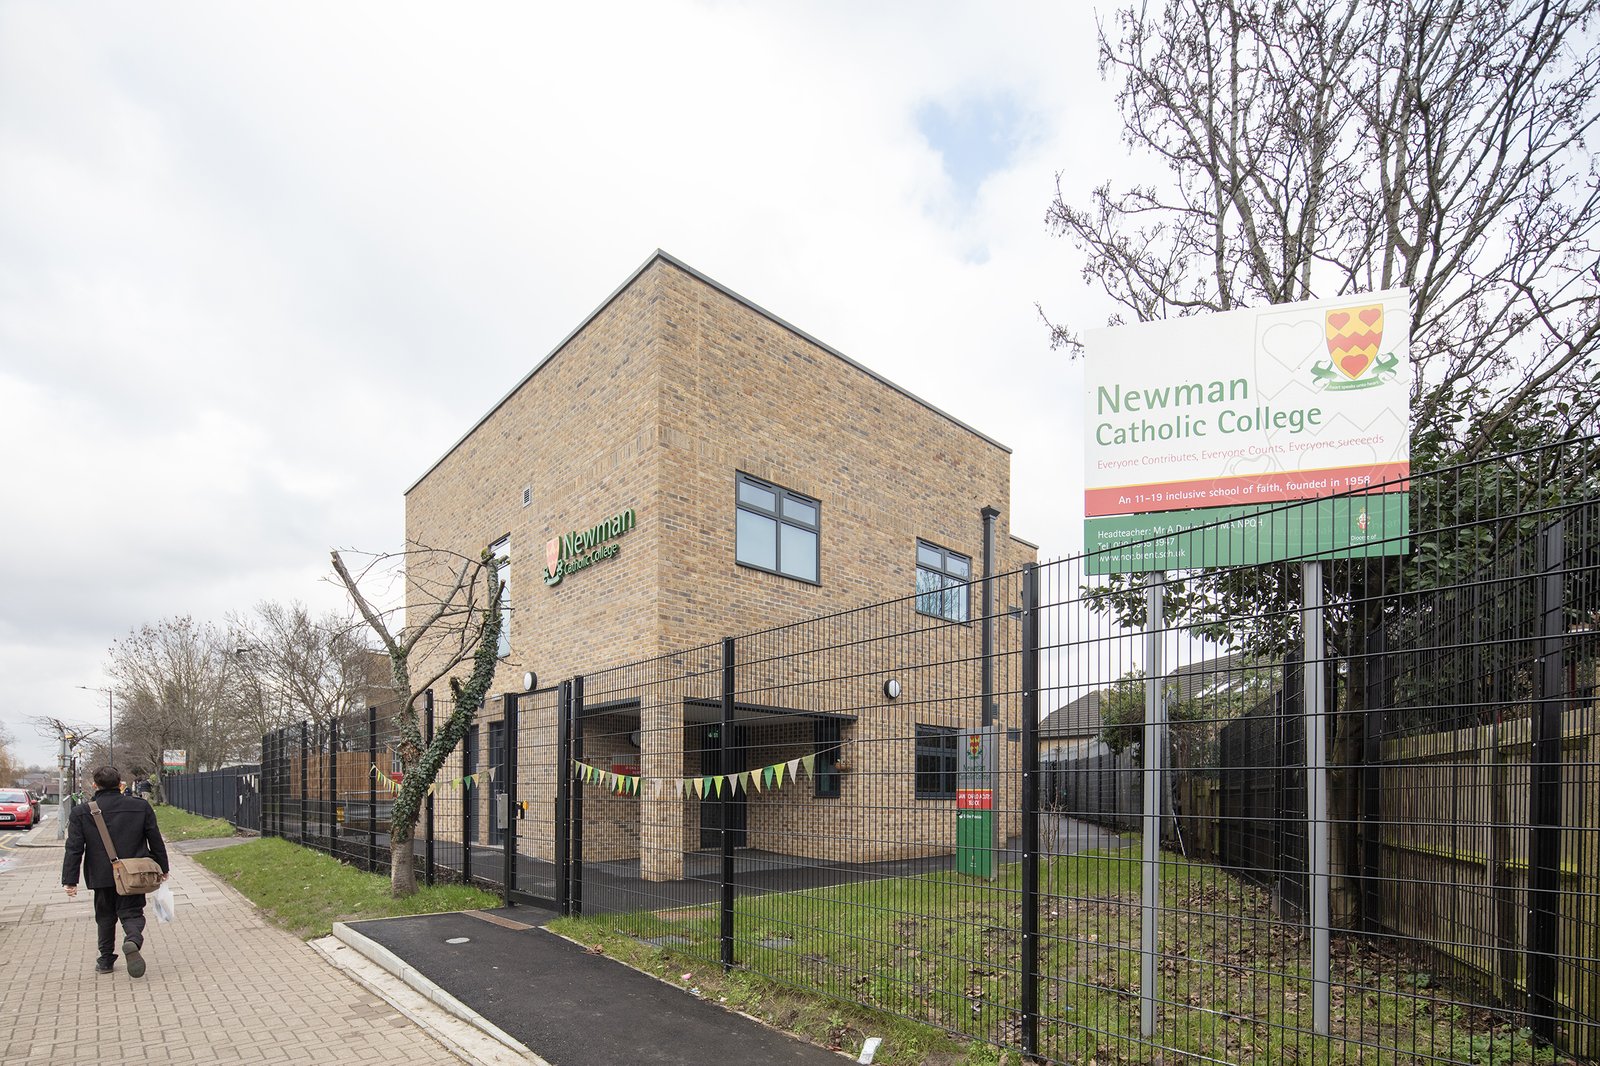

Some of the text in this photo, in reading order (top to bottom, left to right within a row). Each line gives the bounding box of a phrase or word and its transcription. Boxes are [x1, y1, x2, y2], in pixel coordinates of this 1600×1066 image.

[1097, 376, 1249, 415] Newman
[1095, 406, 1322, 446] Catholic College
[1097, 433, 1385, 470] Everyone Contributes, Everyone Counts, Everyone succeeds
[1118, 495, 1132, 505] An
[1165, 489, 1207, 501] inclusive
[1209, 486, 1240, 497] school
[1242, 484, 1254, 494] of
[1256, 483, 1283, 494] faith,
[1286, 479, 1327, 491] founded
[1330, 478, 1341, 488] in
[1344, 475, 1371, 487] 1958
[564, 507, 635, 560] Newman
[1097, 528, 1151, 539] Headteacher:
[1153, 526, 1165, 535] Mr
[1167, 525, 1174, 534] A
[564, 543, 620, 576] Catholic College
